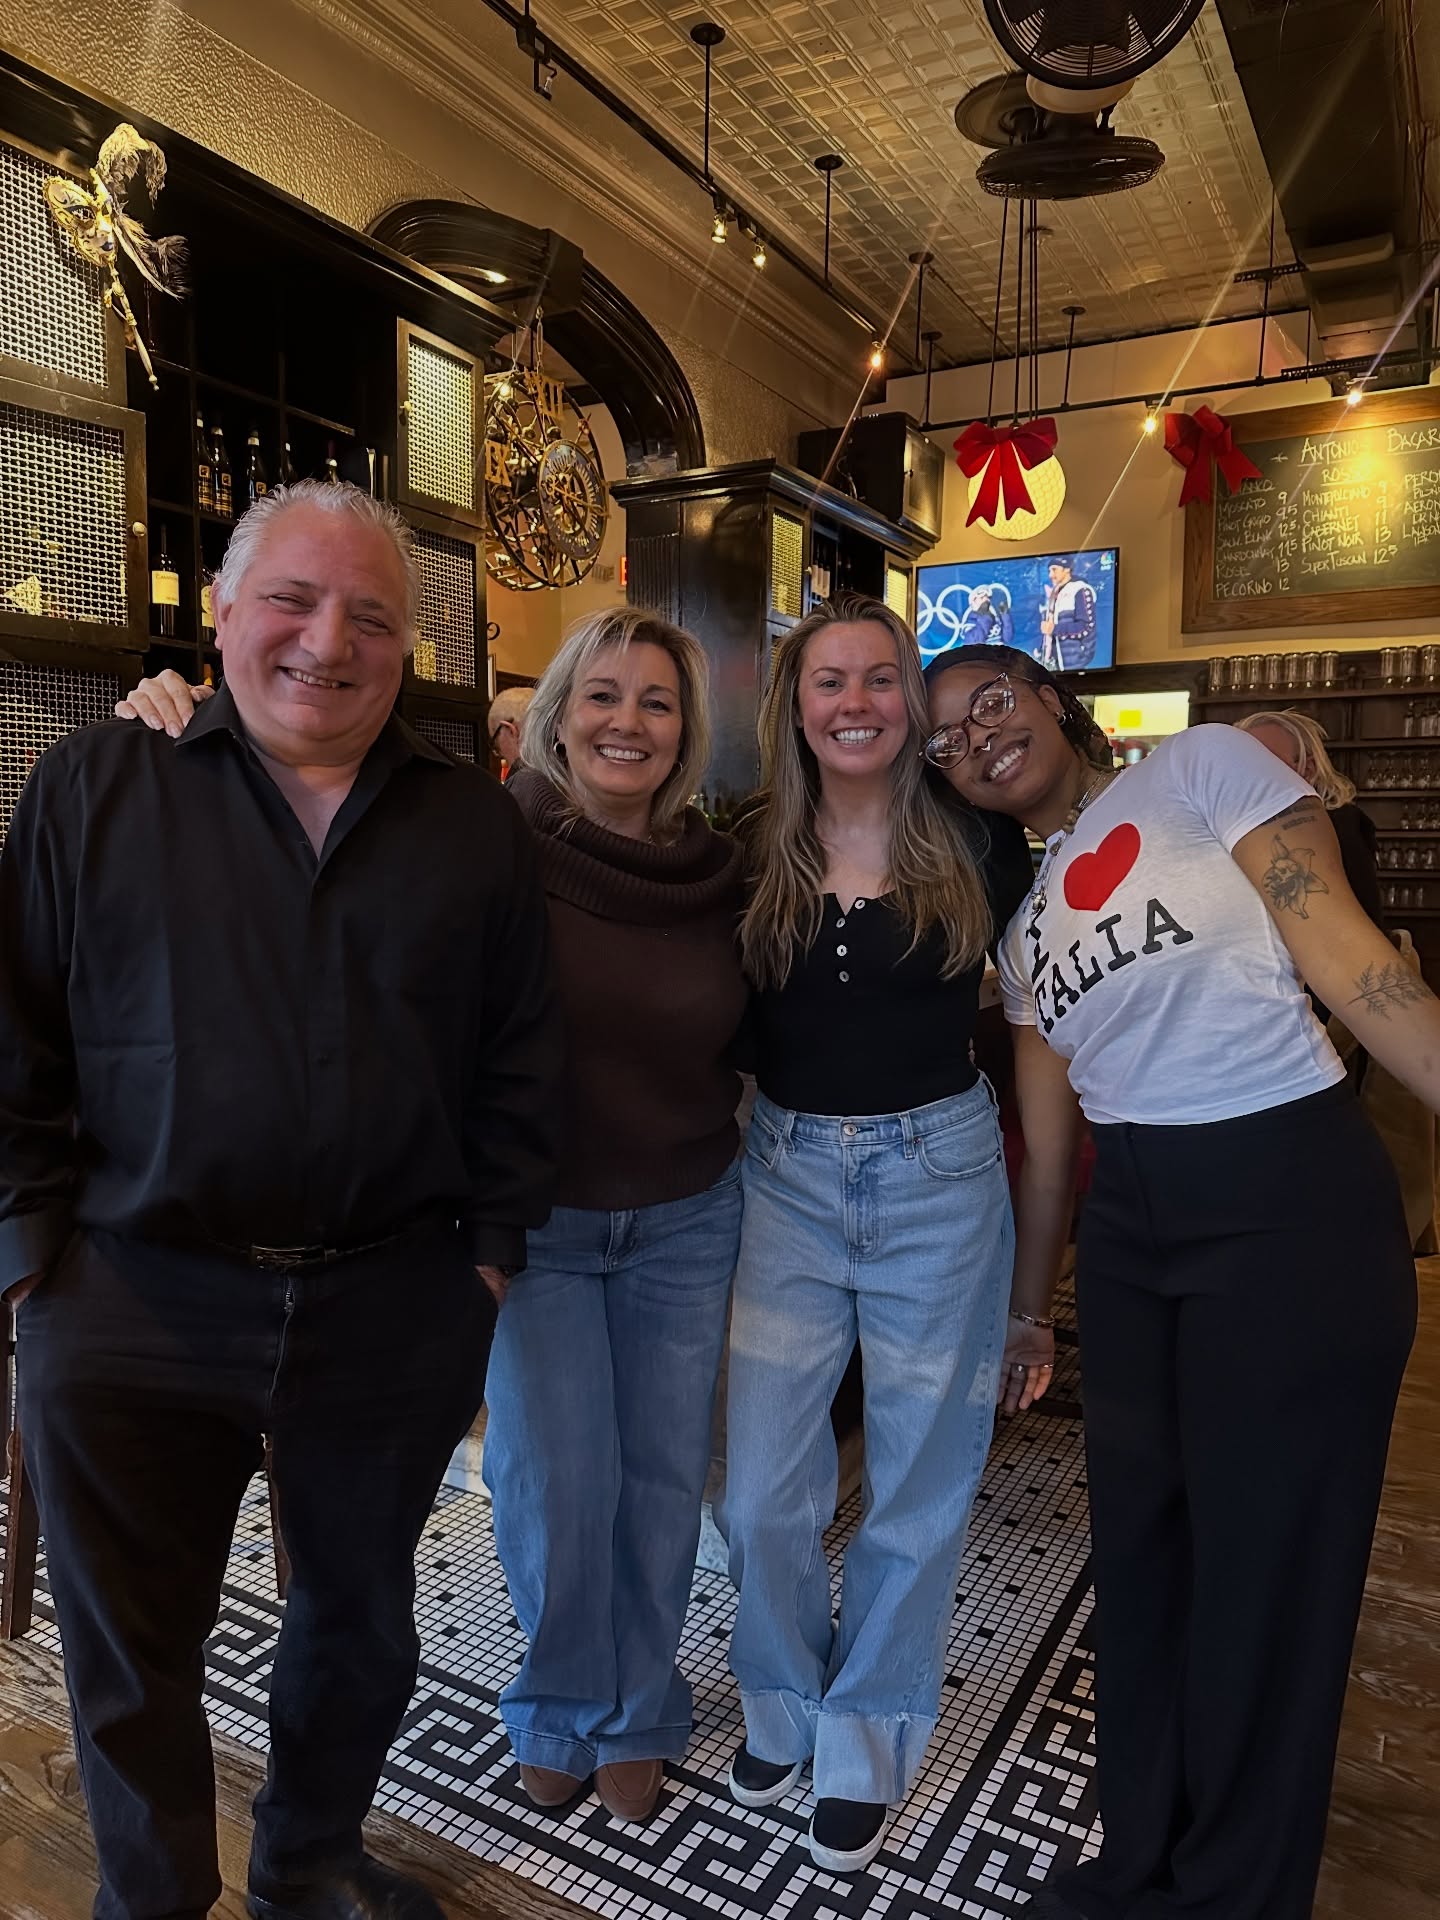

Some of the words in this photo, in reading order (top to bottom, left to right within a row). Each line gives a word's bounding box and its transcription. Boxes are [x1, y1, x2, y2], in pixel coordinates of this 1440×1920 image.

[1386, 427, 1440, 452] BACAR
[1379, 480, 1388, 495] 9
[1405, 470, 1440, 489] PERO
[1219, 498, 1266, 518] MOSCATO
[1278, 491, 1288, 505] 9
[1302, 505, 1350, 524] CHIANTI
[1376, 495, 1387, 508] 9
[1219, 517, 1240, 533] PINOT
[1302, 514, 1360, 538] CABERNET
[1375, 509, 1387, 526] 11
[1301, 536, 1335, 553] PINOT
[1337, 531, 1364, 548] NOIR
[1375, 525, 1391, 544] 13
[1276, 557, 1291, 574] 13
[1215, 577, 1272, 598] PECORINO
[1279, 577, 1290, 591] 12
[1035, 898, 1194, 1044] TALIA
